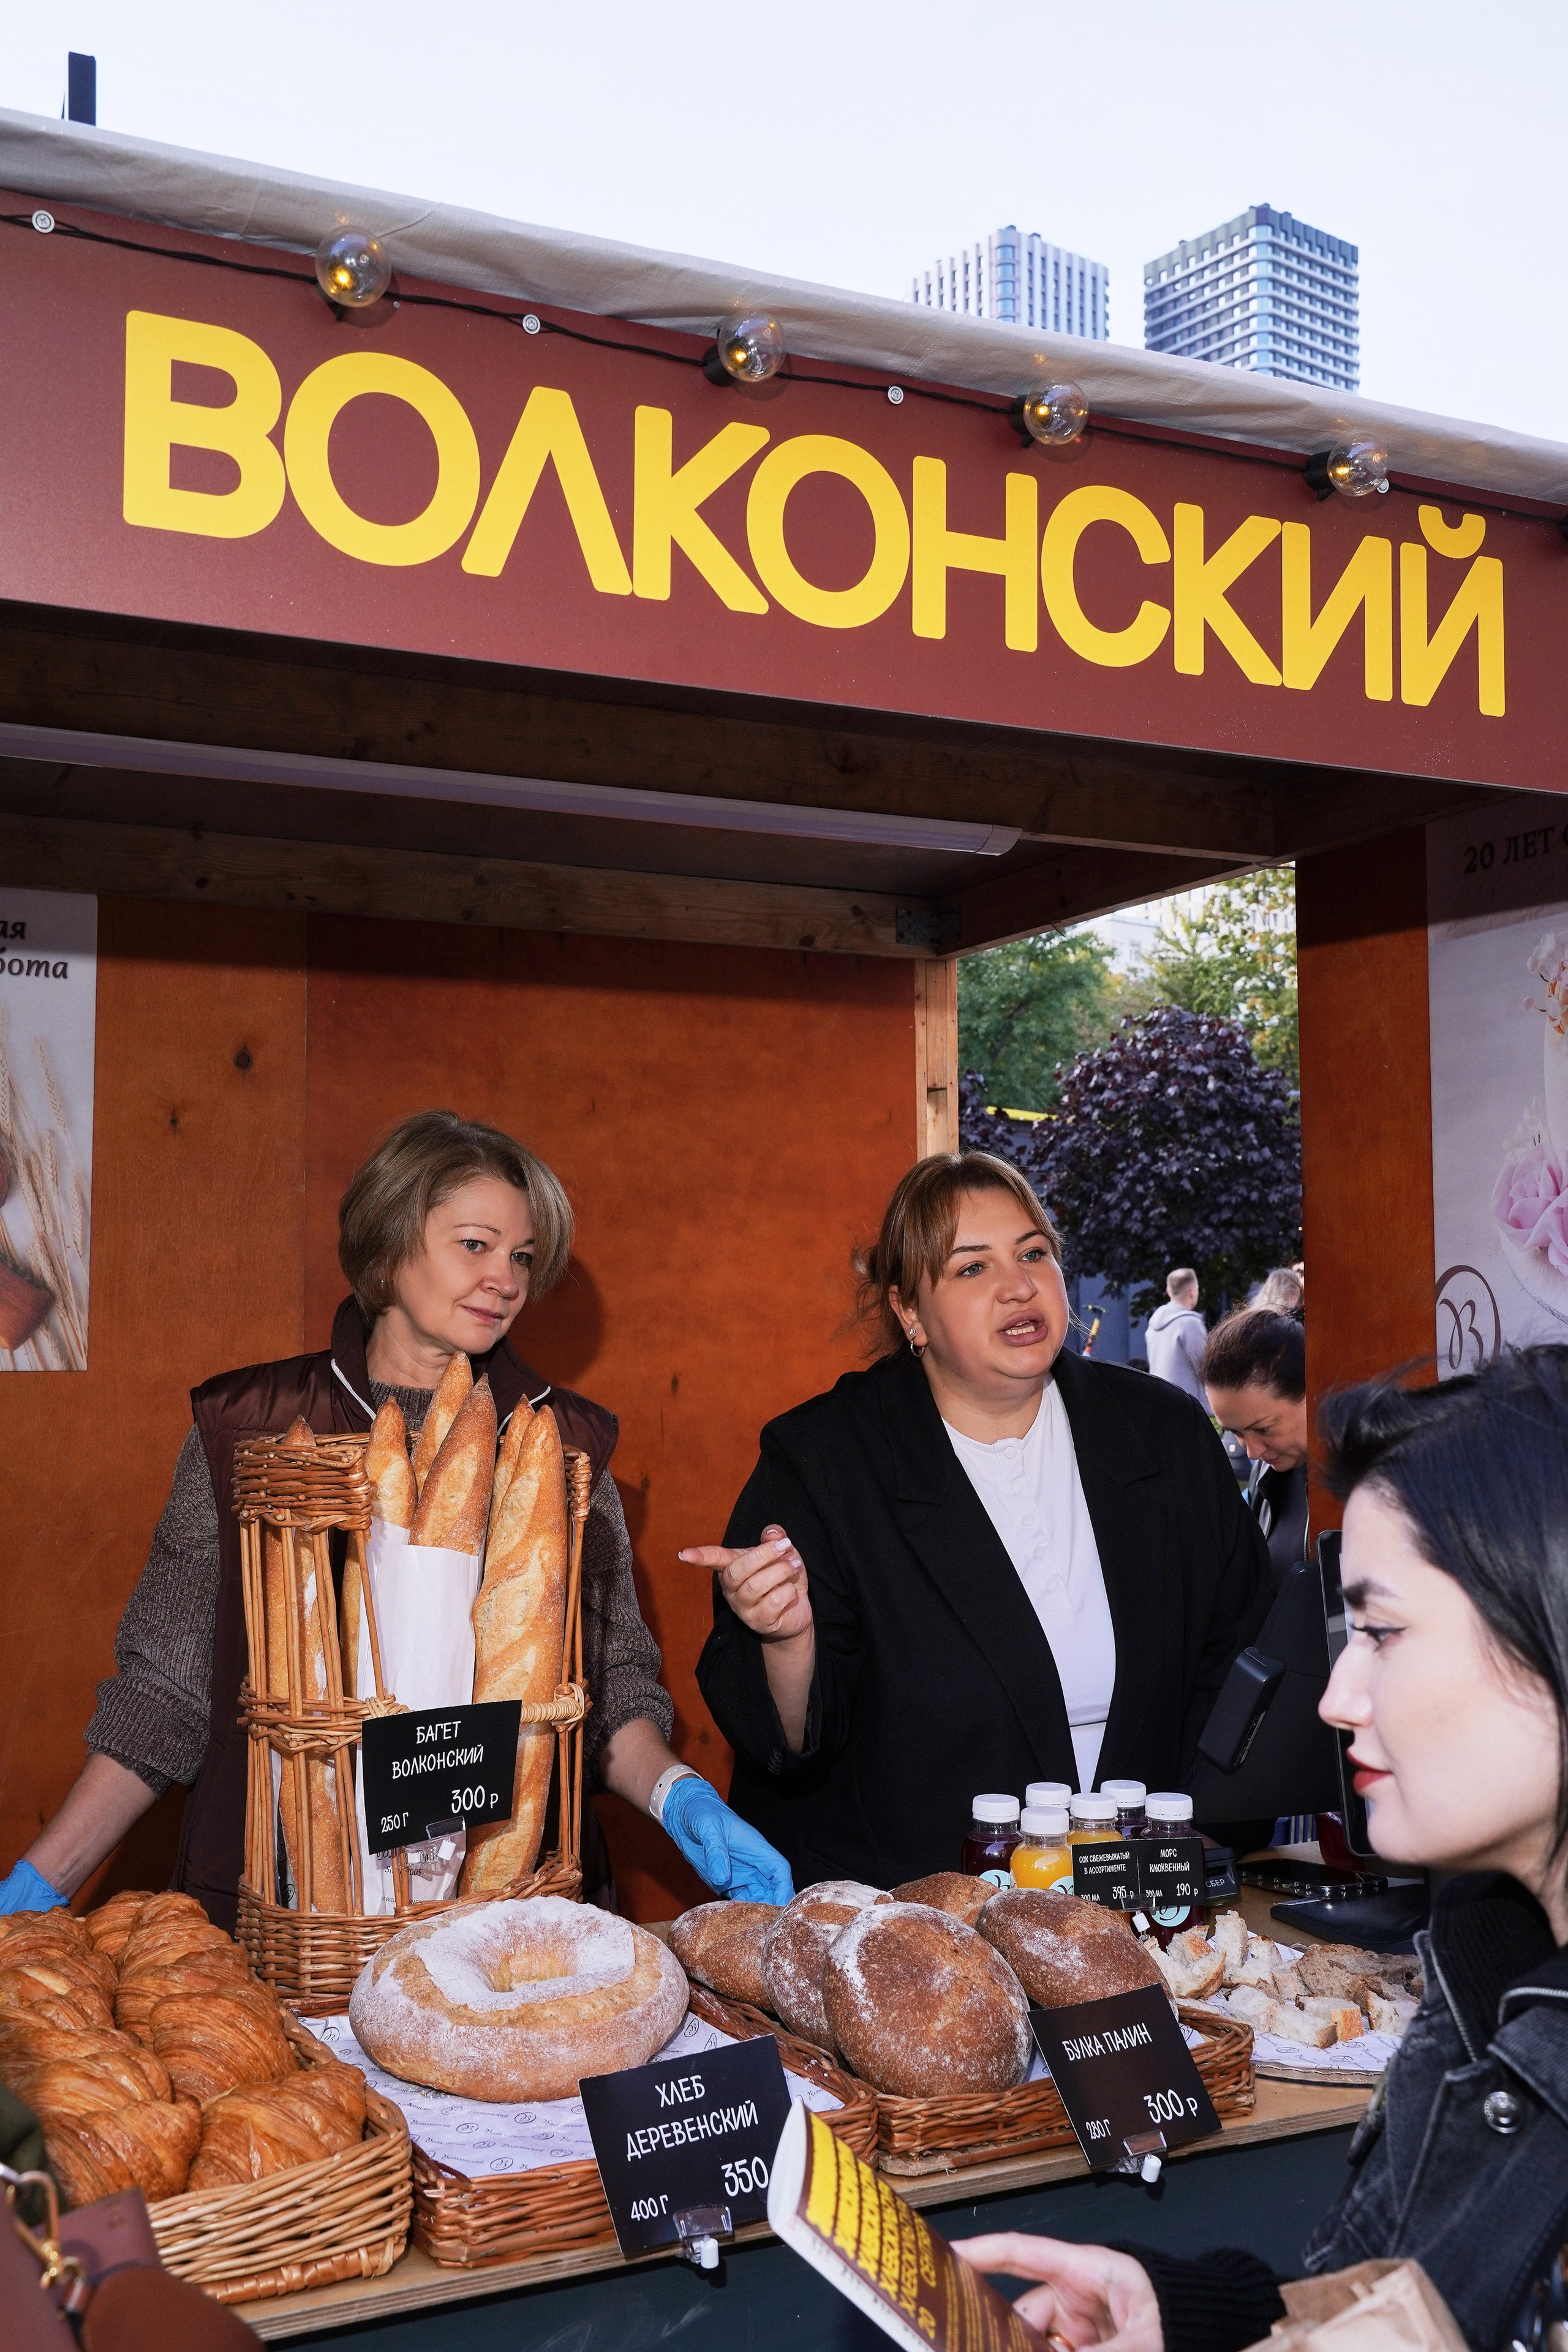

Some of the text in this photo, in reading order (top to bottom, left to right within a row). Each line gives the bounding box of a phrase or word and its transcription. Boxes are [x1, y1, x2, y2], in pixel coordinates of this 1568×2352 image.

[123, 310, 1506, 717] ВОЛКОНСКИЙ
[1463, 842, 1495, 874] 20
[1502, 826, 1555, 864] ЛЕТ
[416, 1721, 461, 1744] БАГЕТ
[391, 1744, 484, 1780] ВОЛКОНСКИЙ
[451, 1785, 486, 1814] 300
[381, 1814, 401, 1833] 250
[1079, 1850, 1130, 1864] СОК СВЕЖЕВЫЖАТЫЙ
[1160, 1848, 1177, 1858] МОРС
[1088, 1863, 1126, 1875] АССОРТИМЕНТЕ
[1149, 1861, 1190, 1873] КЛЮКВЕННЫЙ
[1112, 1885, 1127, 1899] 395
[1176, 1883, 1191, 1896] 190
[1205, 1879, 1225, 1888] СБЕР
[1061, 2022, 1153, 2061] БУЛКА ПАЛИН
[655, 2075, 706, 2108] ХЛЕБ
[1143, 2089, 1185, 2124] 300
[626, 2100, 759, 2162] ДЕРЕВЕНСКИЙ
[1085, 2120, 1106, 2140] 280
[720, 2156, 769, 2197] 350
[630, 2197, 658, 2222] 400
